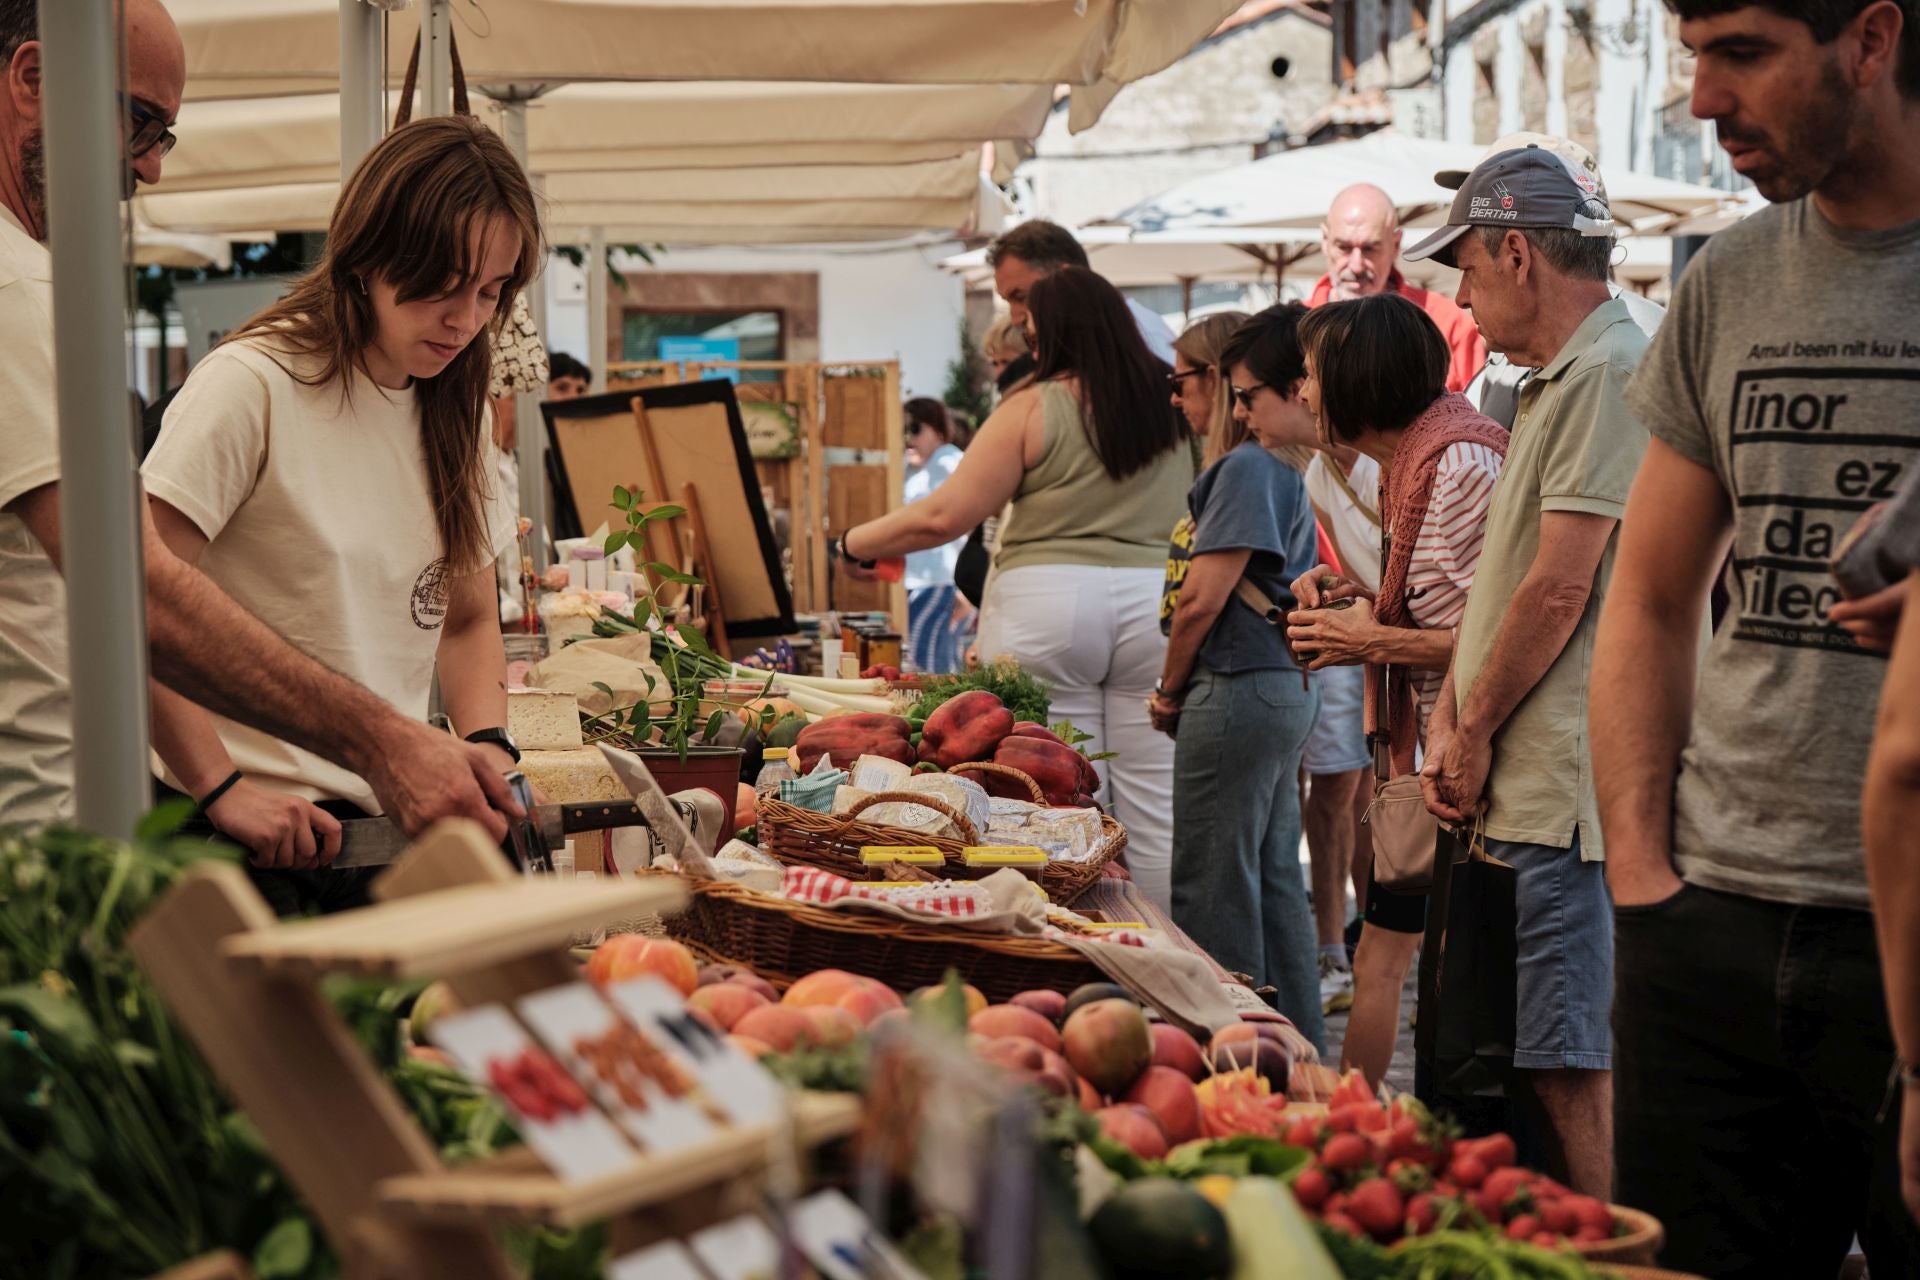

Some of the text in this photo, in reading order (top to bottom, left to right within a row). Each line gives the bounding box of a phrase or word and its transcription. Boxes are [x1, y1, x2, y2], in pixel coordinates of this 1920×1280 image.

[1469, 207, 1518, 220] BERTHA
[1470, 196, 1492, 207] BIG
[1870, 339, 1896, 358] ku
[1744, 383, 1848, 431] inor
[1835, 460, 1903, 499] ez
[1765, 509, 1834, 558] da
